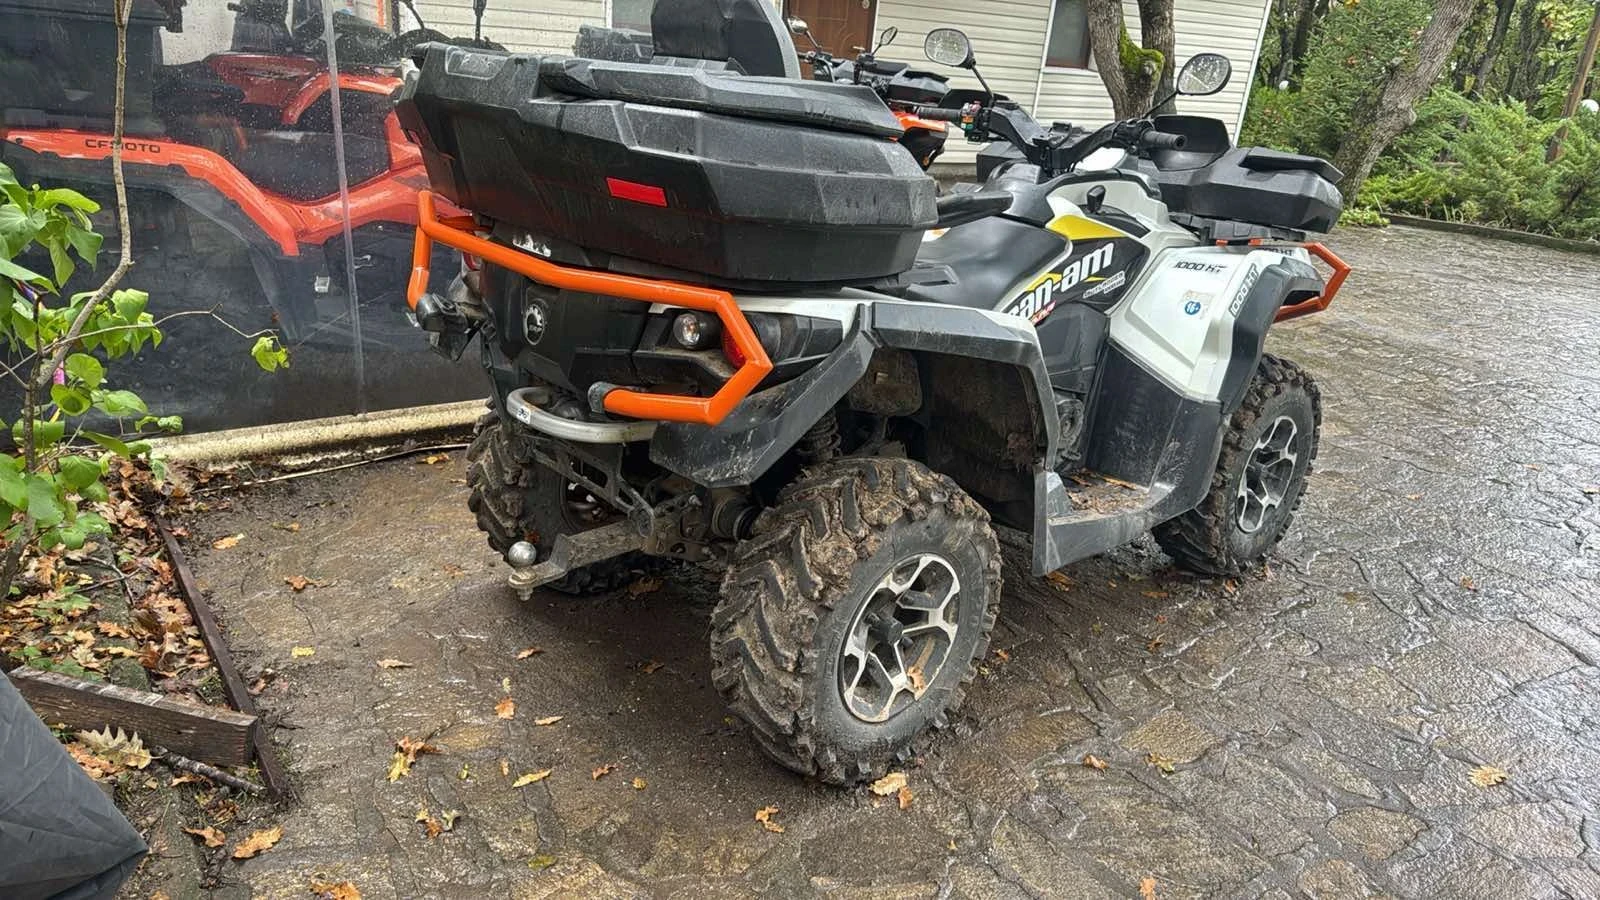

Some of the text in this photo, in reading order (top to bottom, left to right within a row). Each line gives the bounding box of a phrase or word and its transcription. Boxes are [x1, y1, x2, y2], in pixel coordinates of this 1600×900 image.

[85, 139, 161, 153] CFOTO
[1174, 261, 1205, 271] 1000
[1230, 284, 1248, 315] 1000
